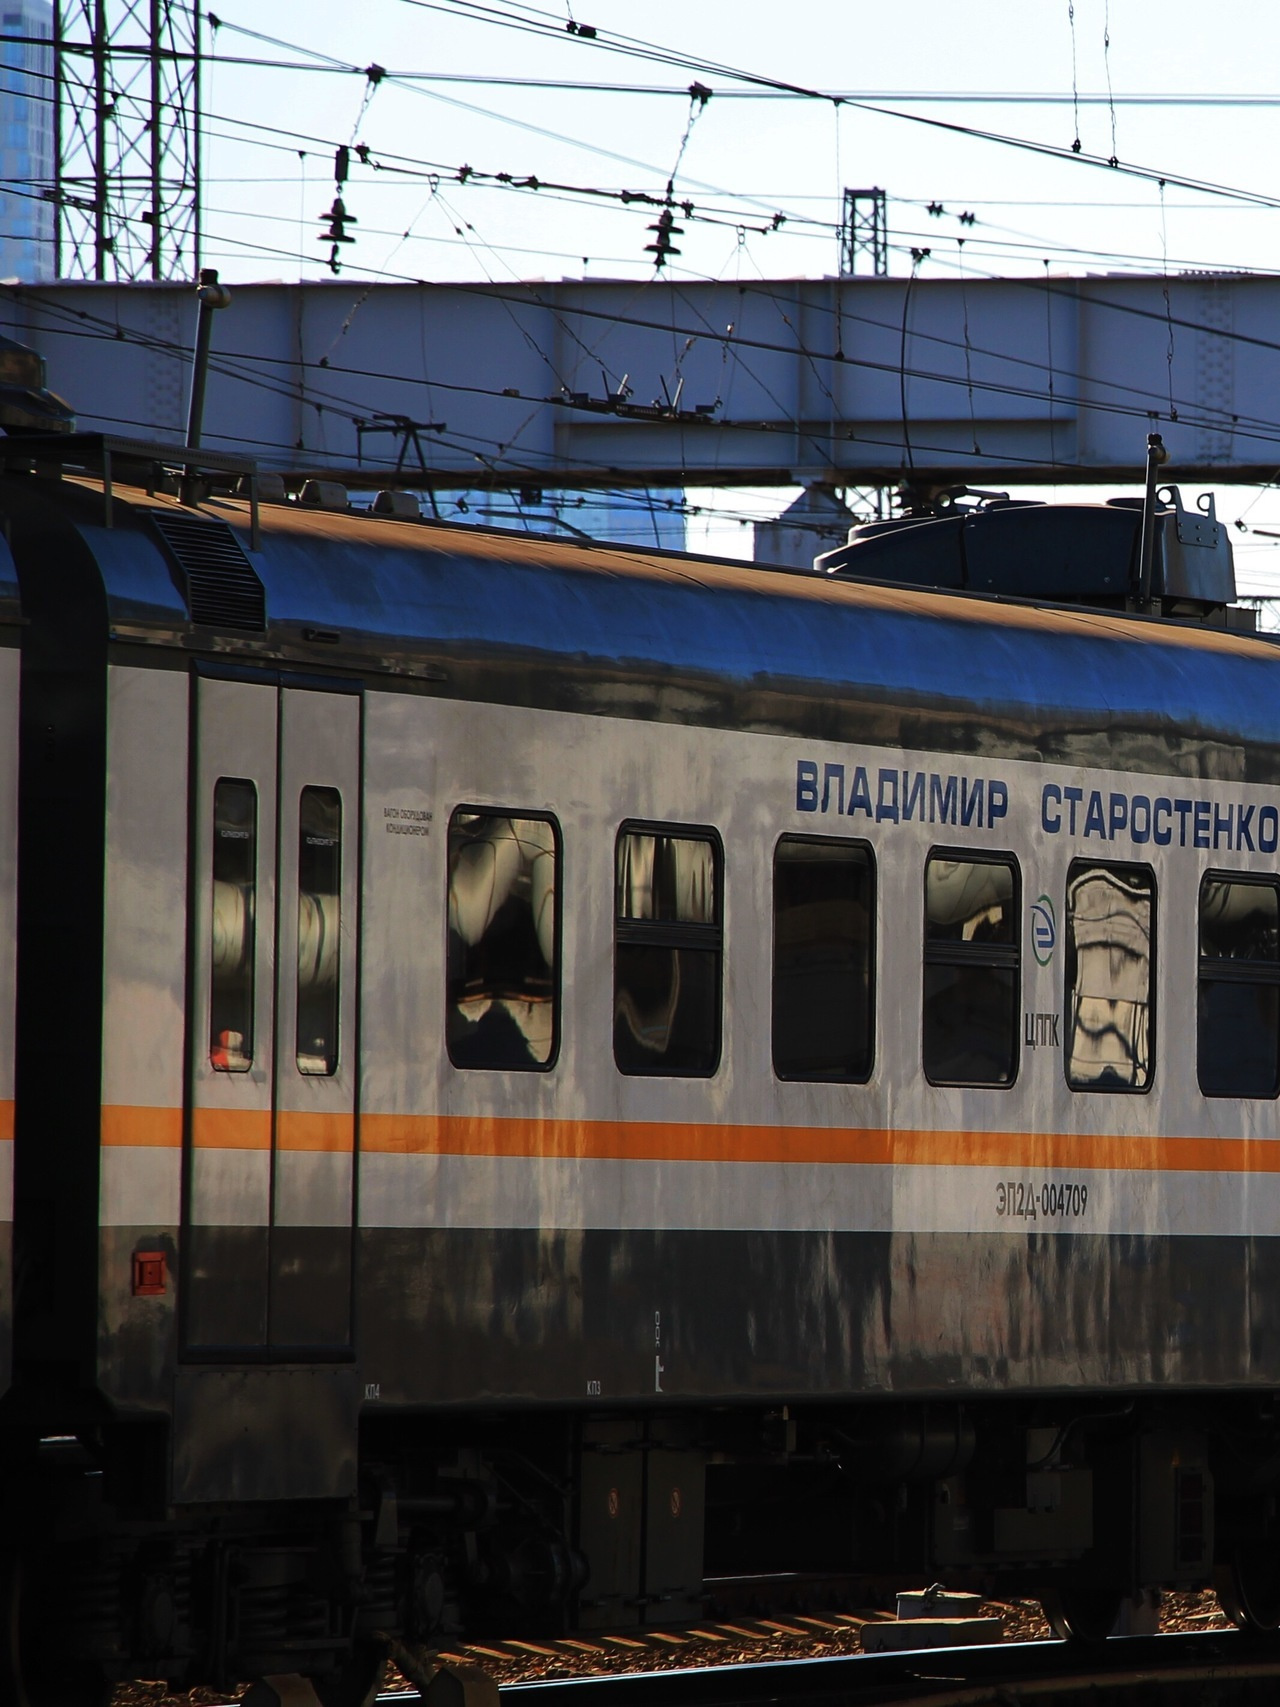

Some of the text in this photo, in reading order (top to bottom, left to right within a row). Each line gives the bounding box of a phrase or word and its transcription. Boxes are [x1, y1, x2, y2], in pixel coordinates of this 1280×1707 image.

[796, 760, 1278, 853] ВЛАДИМИР СТАРОСТЕНКО
[1025, 1013, 1059, 1050] ЦППК
[996, 1182, 1087, 1220] ЭП2Д-004709
[364, 1383, 380, 1399] КП4
[586, 1380, 601, 1395] КП3
